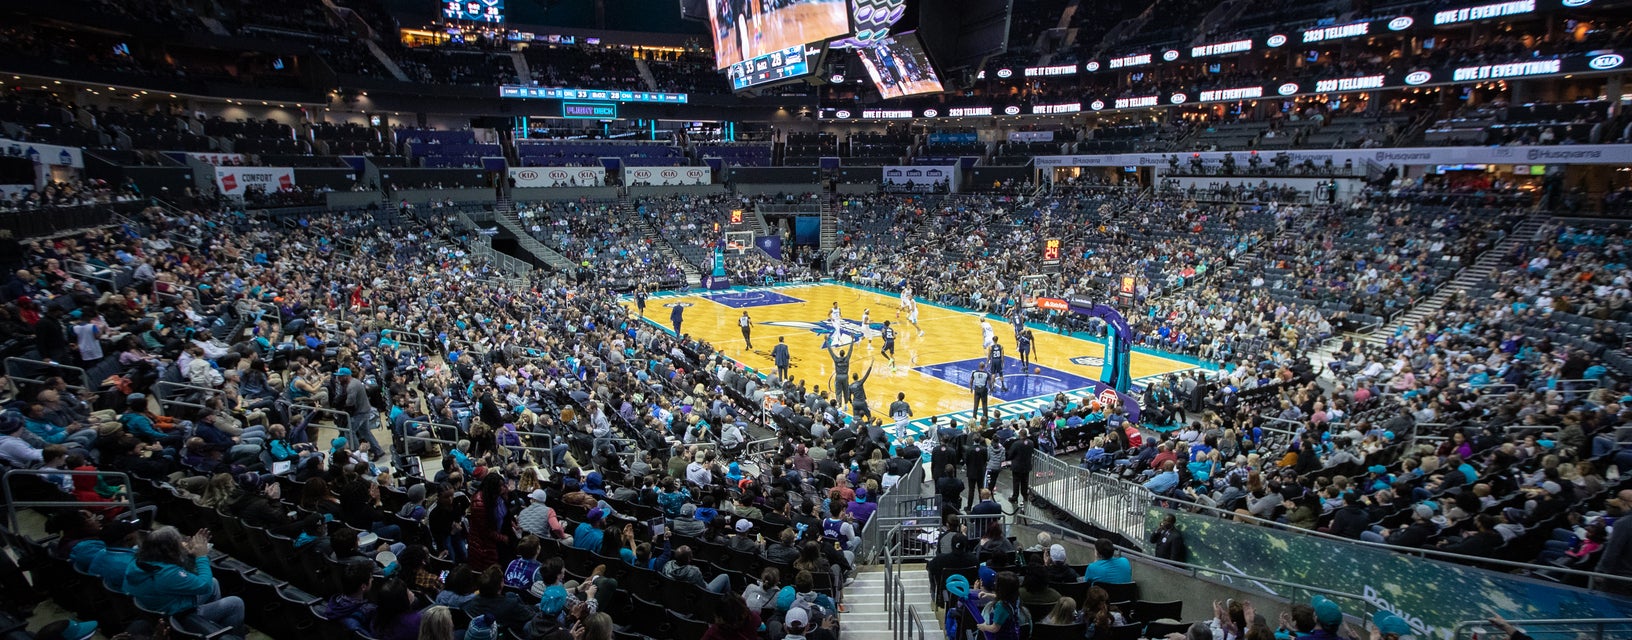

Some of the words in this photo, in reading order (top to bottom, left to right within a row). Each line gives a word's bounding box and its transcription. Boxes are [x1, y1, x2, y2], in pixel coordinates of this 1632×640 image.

[1434, 10, 1458, 25] GIVE
[1458, 8, 1470, 22] IT
[1469, 0, 1536, 20] EVERYTHING
[1302, 28, 1324, 43] 2020
[1324, 22, 1369, 40] TELLURIDE
[1191, 46, 1206, 58] GIVE
[1206, 45, 1213, 56] IT
[1213, 39, 1252, 55] EVERYTHING
[1124, 54, 1152, 66] TELLURIDE
[1025, 68, 1038, 76] GIVE
[1038, 67, 1045, 76] IT
[1045, 65, 1077, 75] EVERYTHING
[1453, 66, 1479, 81] GIVE
[1478, 64, 1491, 79] IT
[1491, 59, 1561, 78] EVERYTHING
[1315, 80, 1338, 92] 2020
[1338, 75, 1385, 91] TELLURIDE
[1200, 91, 1215, 102] GIVE
[1215, 90, 1222, 100] IT
[1222, 87, 1263, 100] EVERYTHING
[1129, 96, 1158, 107] TELLURIDE
[594, 107, 614, 115] DECK
[1033, 105, 1046, 114] GIVE
[1046, 104, 1053, 113] IT
[1053, 103, 1081, 113] EVERYTHING
[863, 111, 875, 119] GIVE
[875, 111, 881, 119] IT
[881, 110, 913, 118] EVERYTHING
[1384, 152, 1431, 160] Husqvarna
[1541, 149, 1602, 160] Husqvarna
[242, 174, 273, 182] COMFORT
[1045, 248, 1058, 260] 24
